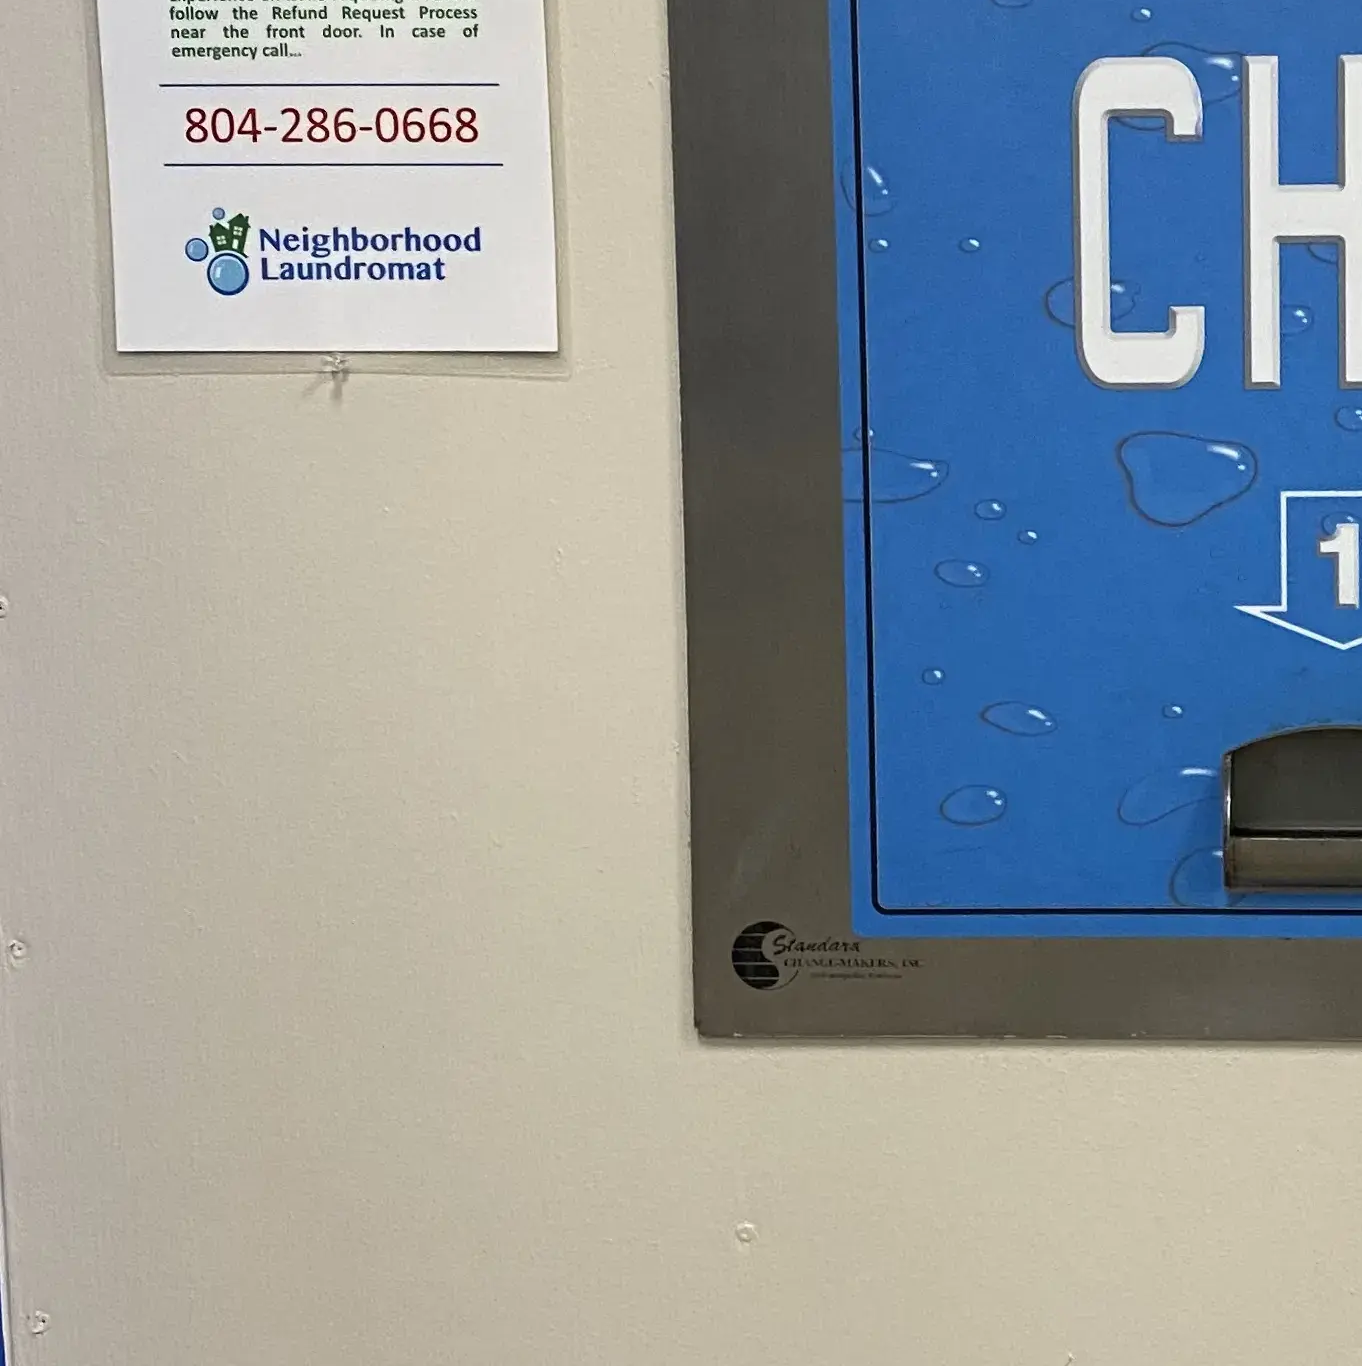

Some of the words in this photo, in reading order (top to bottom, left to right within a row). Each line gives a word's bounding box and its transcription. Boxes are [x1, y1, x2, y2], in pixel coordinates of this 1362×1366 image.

[169, 6, 218, 20] follow
[232, 6, 257, 20] the
[272, 6, 327, 19] Refund
[342, 6, 405, 22] Request
[420, 6, 477, 19] Process
[171, 29, 206, 38] near
[223, 25, 248, 38] the
[267, 24, 305, 38] front
[323, 24, 362, 38] door.
[381, 25, 394, 38] In
[412, 28, 445, 37] case
[463, 24, 478, 37] of
[172, 47, 257, 60] emergency
[186, 108, 478, 143] 804-286-0668
[260, 227, 480, 257] Neighborhood
[262, 256, 445, 280] Laundromat
[1317, 522, 1360, 608] 1
